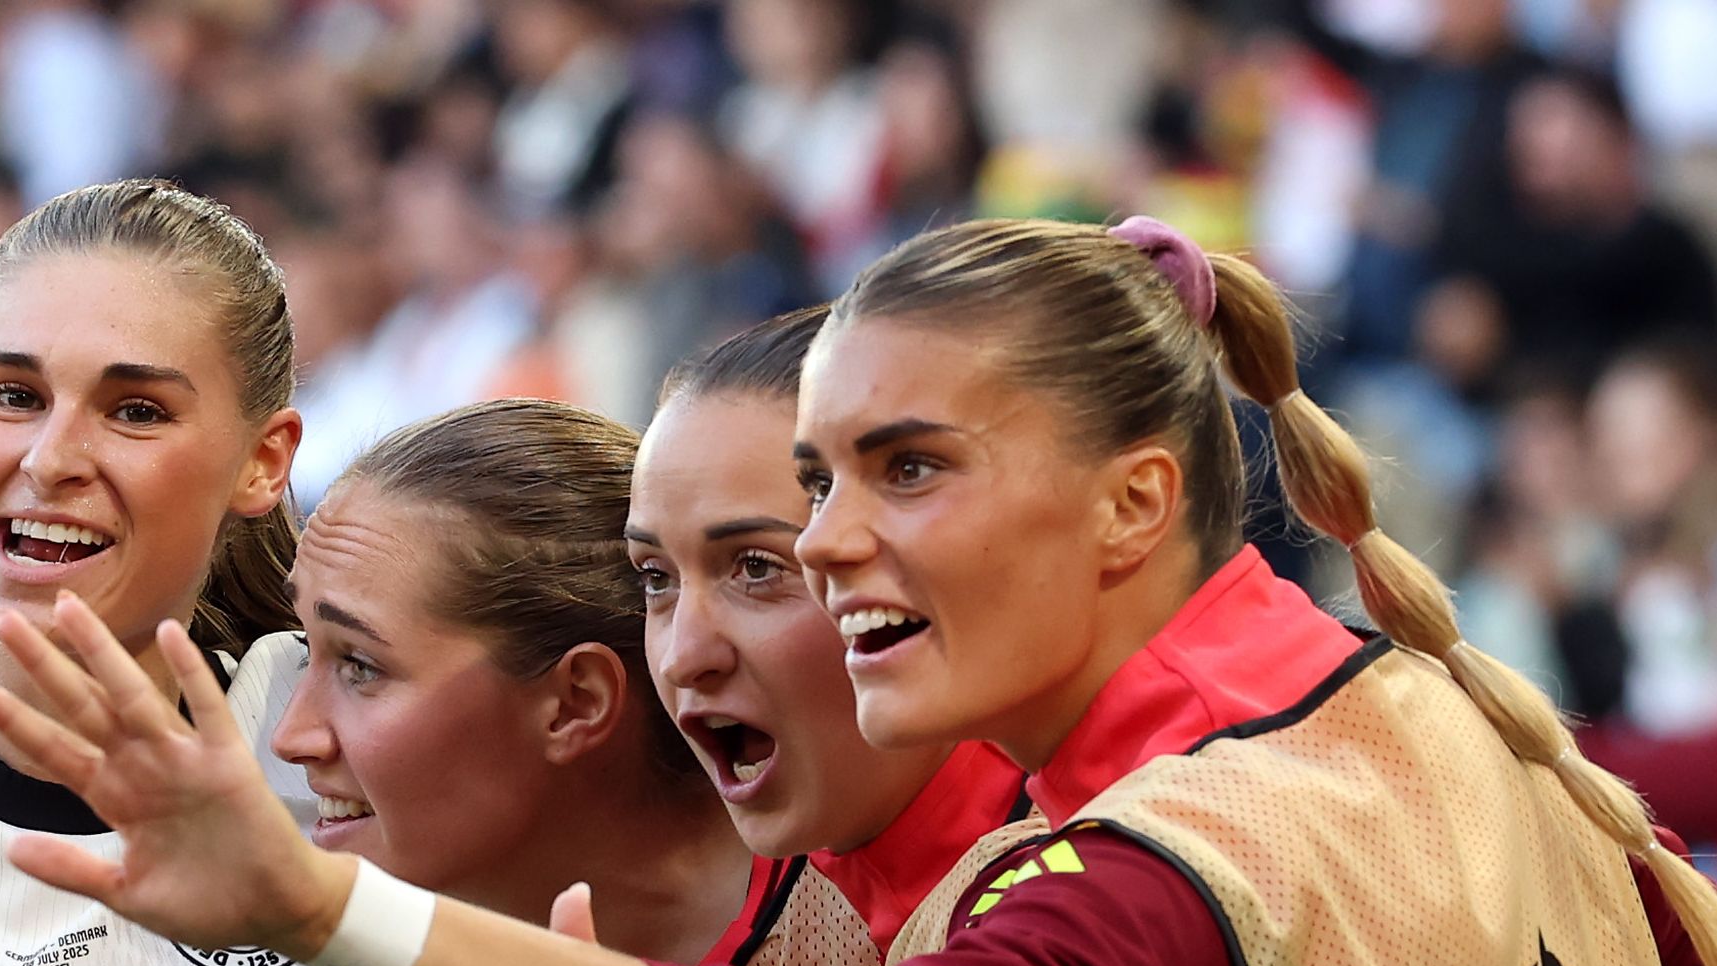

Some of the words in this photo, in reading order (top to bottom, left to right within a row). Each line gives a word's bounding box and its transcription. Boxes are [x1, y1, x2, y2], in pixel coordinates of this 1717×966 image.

[58, 924, 109, 947] DENMARK
[37, 950, 60, 966] JULY
[62, 944, 90, 961] 2025
